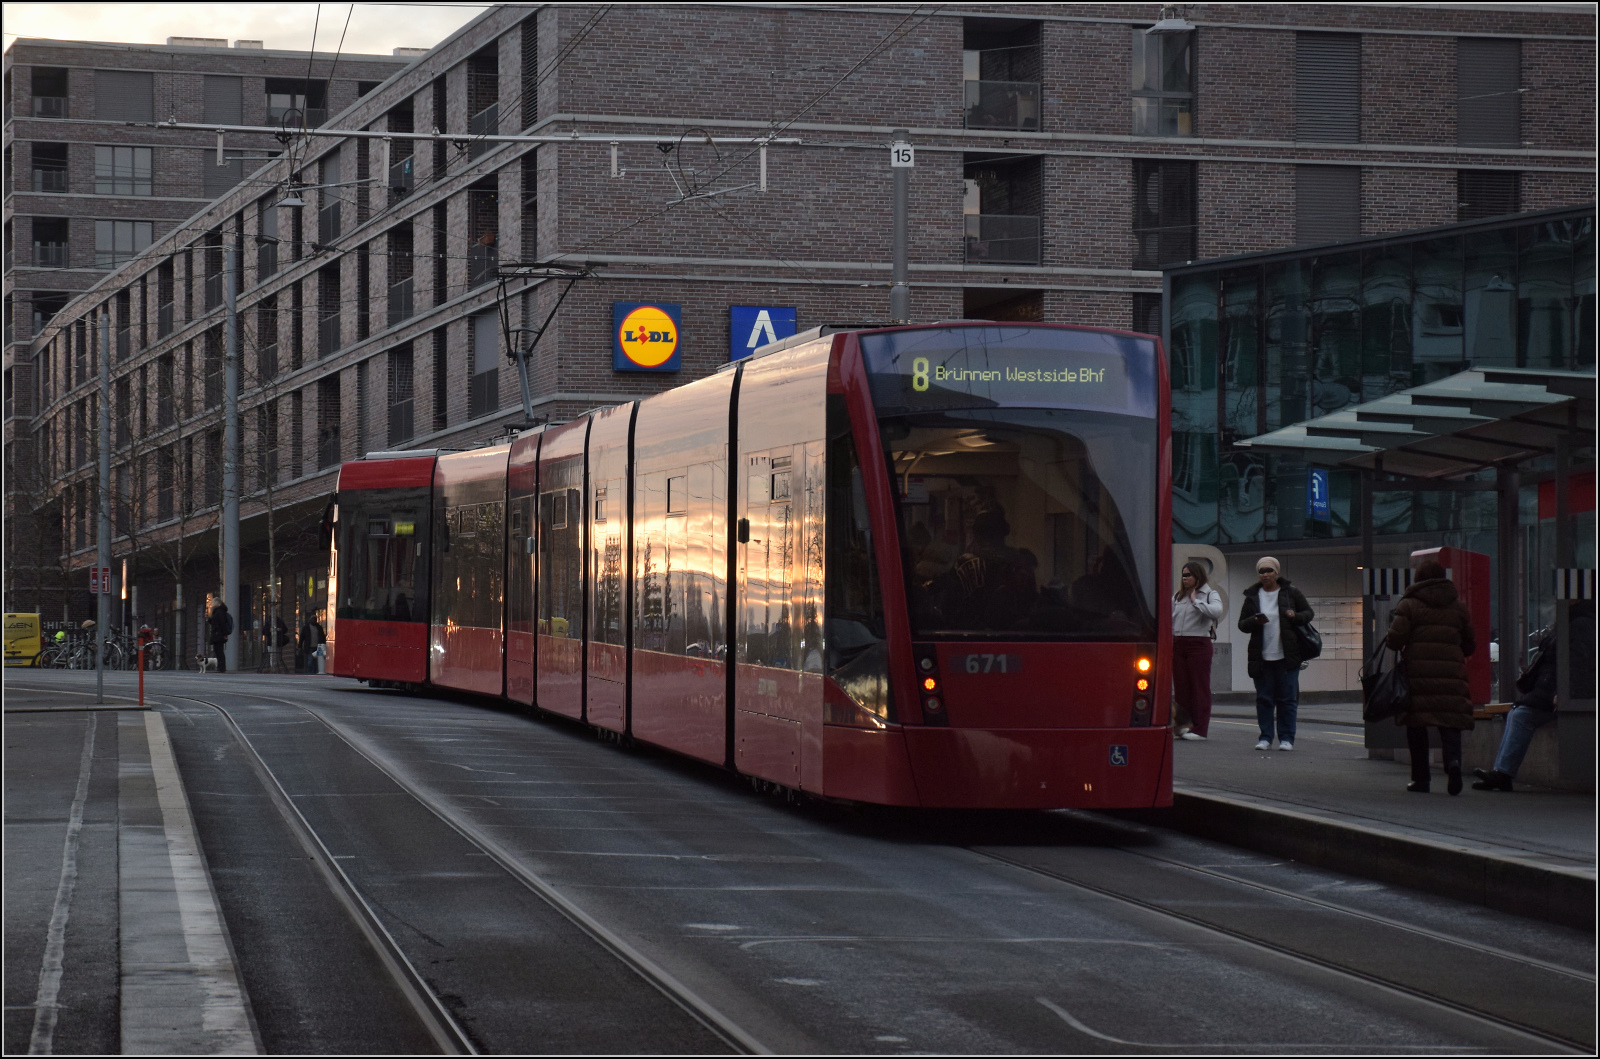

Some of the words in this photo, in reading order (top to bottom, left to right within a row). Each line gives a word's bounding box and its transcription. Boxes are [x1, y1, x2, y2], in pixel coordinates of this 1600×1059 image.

[893, 149, 912, 163] 15
[912, 357, 930, 392] 8
[935, 365, 1001, 382] Brünnen
[1006, 366, 1077, 383] Westside
[1080, 367, 1106, 383] Bhf
[965, 653, 1008, 674] 671
